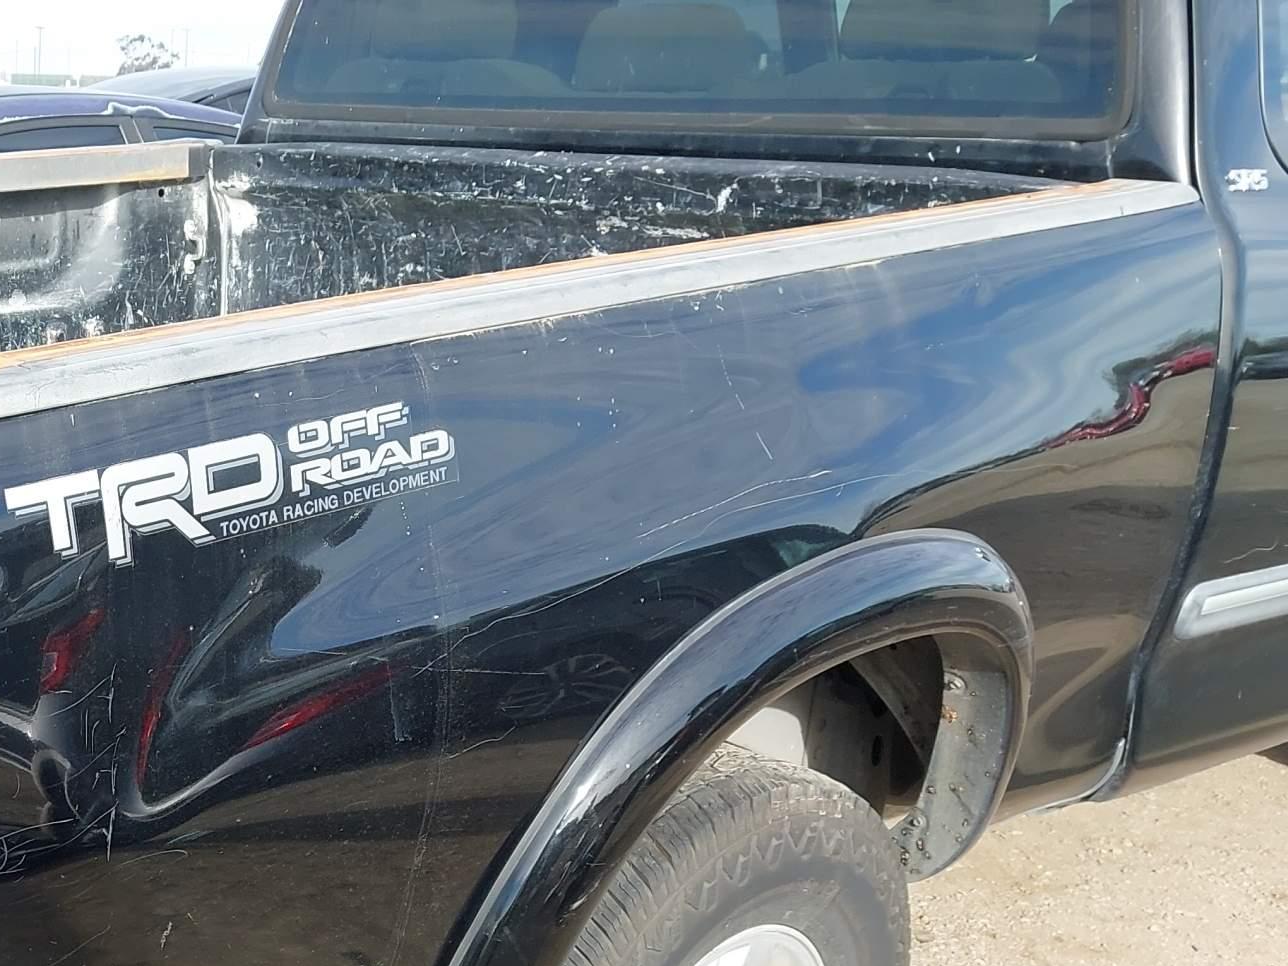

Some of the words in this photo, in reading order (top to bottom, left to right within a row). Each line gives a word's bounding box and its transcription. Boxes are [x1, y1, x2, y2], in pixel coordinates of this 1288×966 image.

[288, 402, 410, 457] OFF
[290, 429, 456, 498] ROAD
[4, 432, 284, 569] TRD
[220, 510, 279, 537] TOYOTA
[283, 496, 339, 522] RACING
[344, 466, 448, 505] DEVELOPMENT
